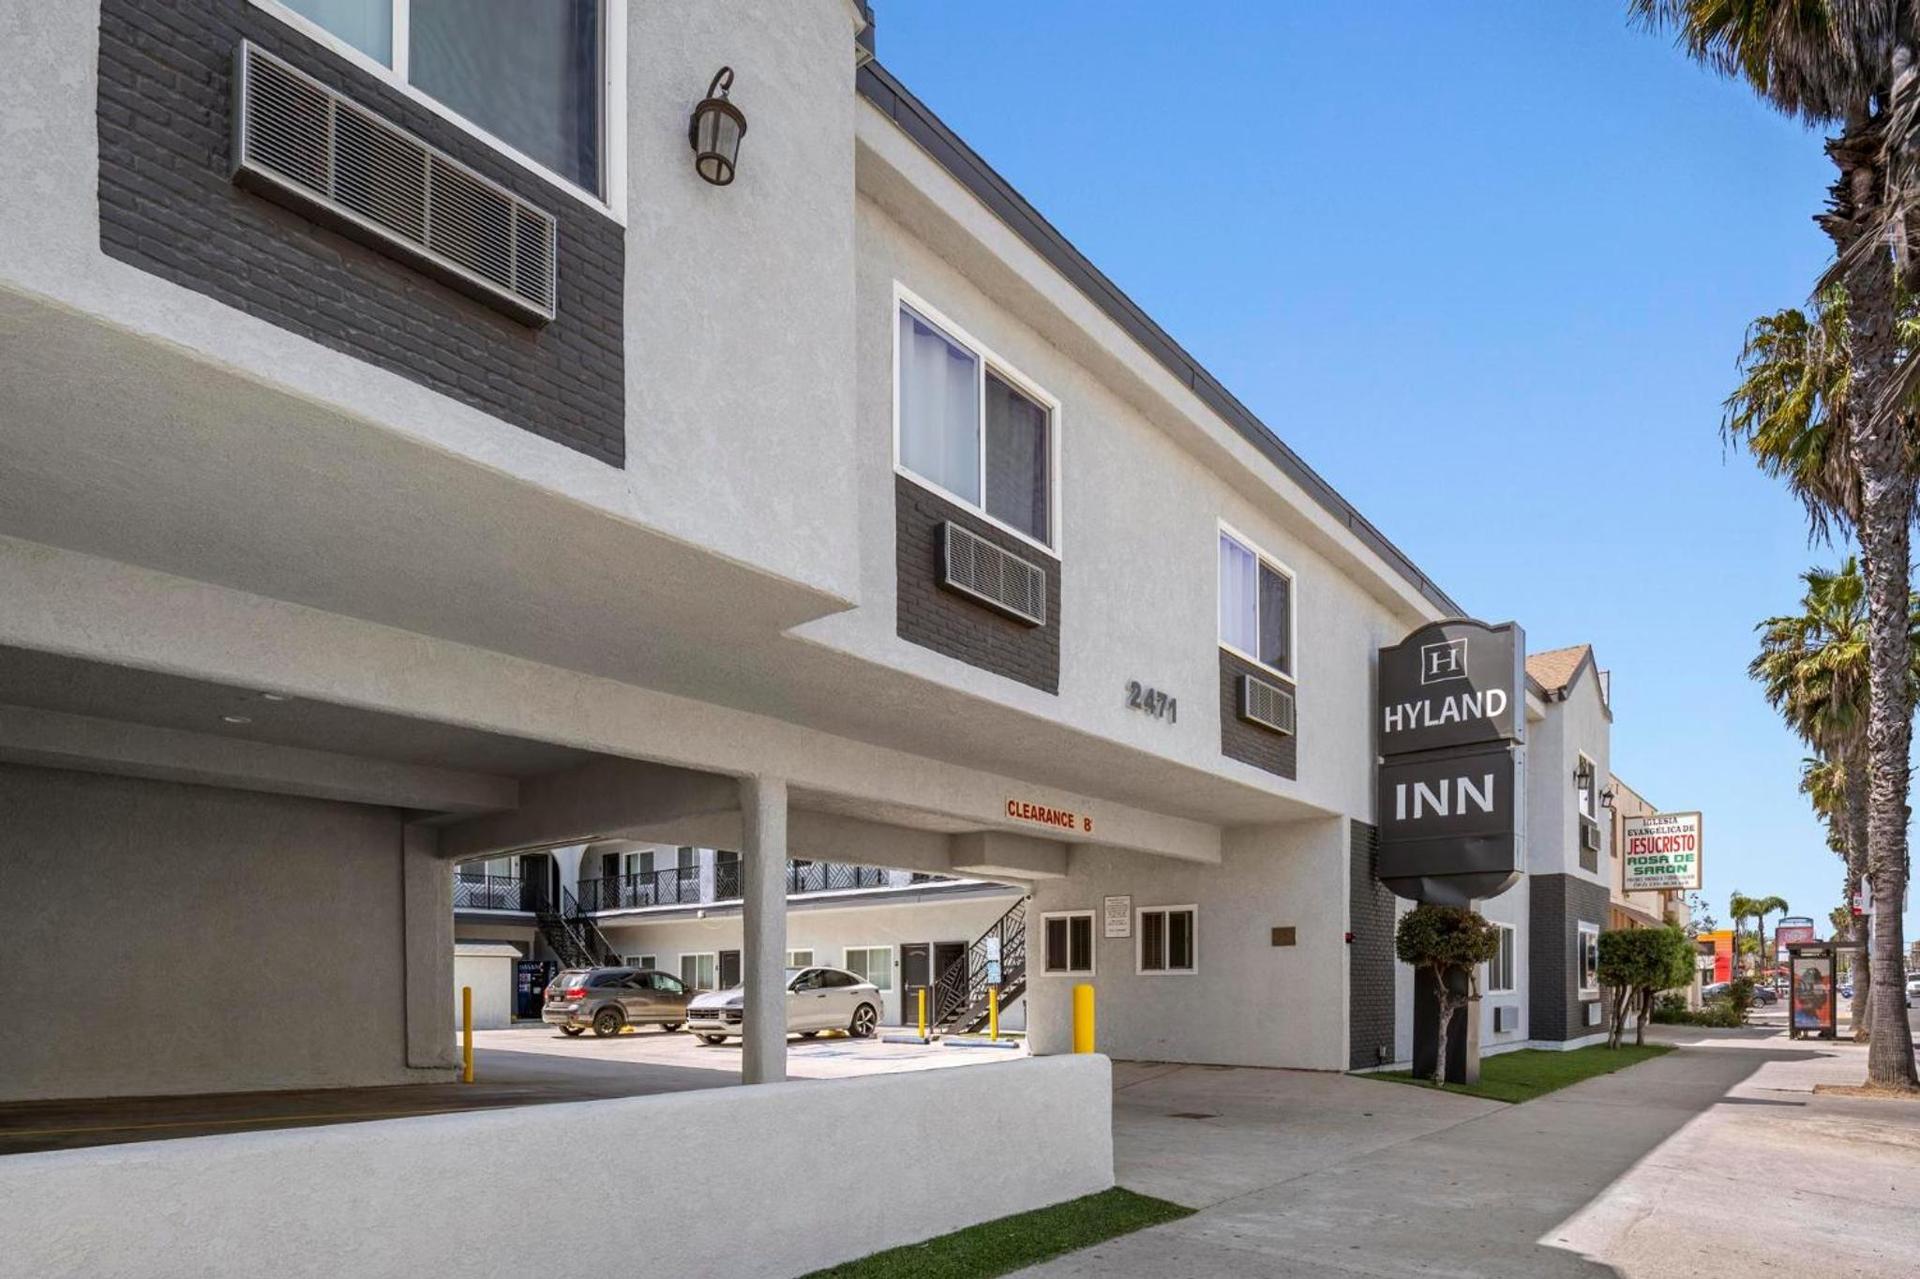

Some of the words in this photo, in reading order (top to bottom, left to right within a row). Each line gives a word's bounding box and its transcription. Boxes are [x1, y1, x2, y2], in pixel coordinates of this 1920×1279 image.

[1428, 648, 1460, 675] H
[1127, 680, 1177, 724] 2471
[1384, 688, 1507, 733] HYLAND
[1396, 774, 1494, 821] INN
[1007, 800, 1074, 828] CLEARANCE
[1643, 816, 1678, 826] IGLESIA
[1683, 824, 1695, 833] DE
[1627, 834, 1695, 855] JESUCRISTO
[1627, 855, 1669, 866] ROSA
[1674, 853, 1695, 863] DE
